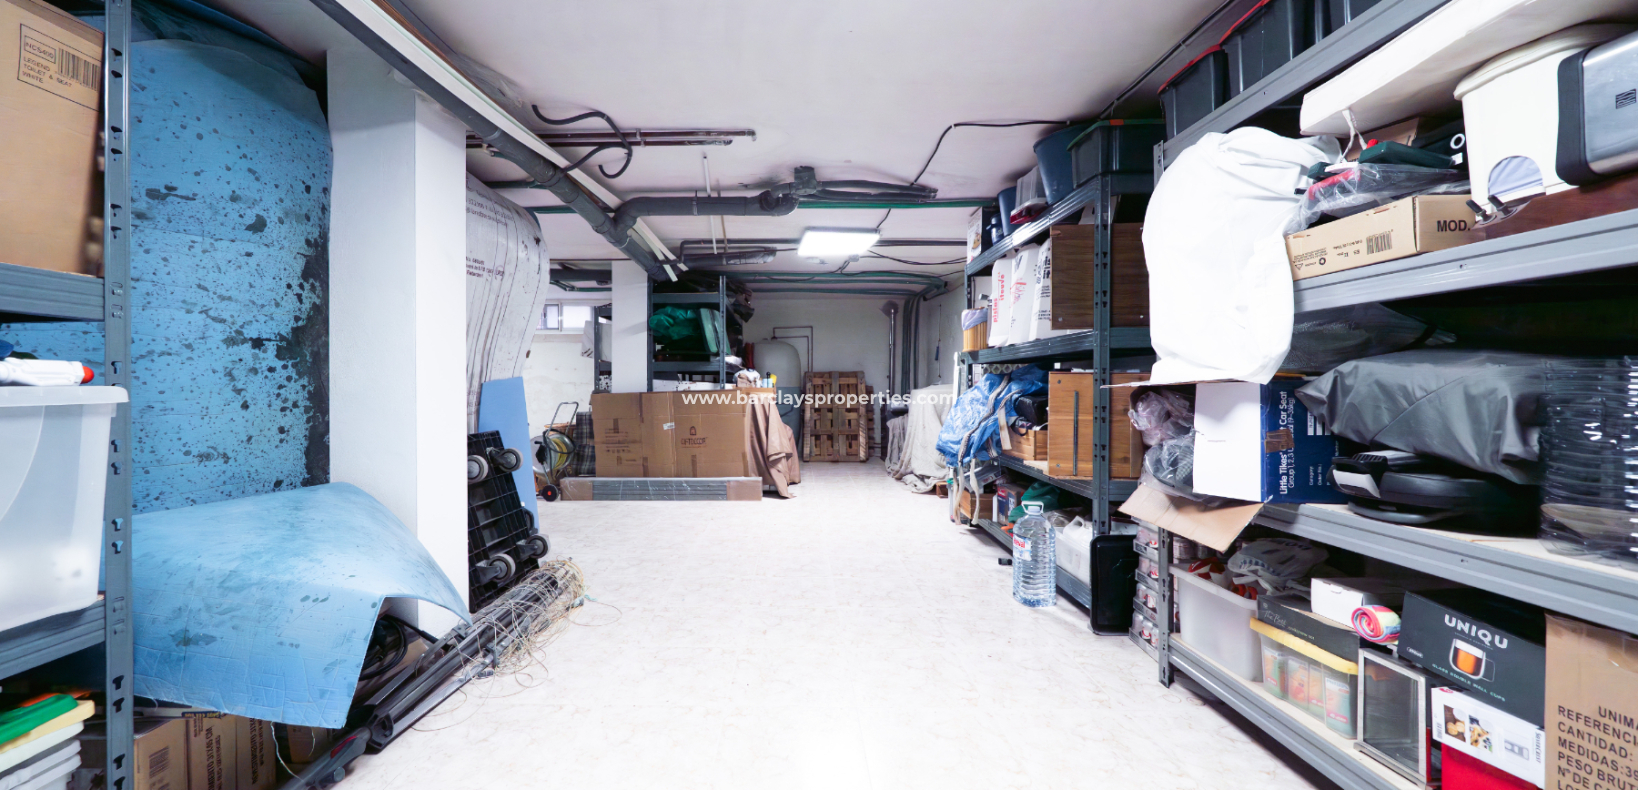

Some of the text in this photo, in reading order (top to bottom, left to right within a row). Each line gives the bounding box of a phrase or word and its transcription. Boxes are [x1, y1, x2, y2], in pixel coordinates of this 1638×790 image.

[23, 56, 51, 72] LEGEND
[22, 70, 44, 84] WHITE
[23, 63, 46, 77] TOILET
[56, 77, 72, 87] SEAT
[1436, 219, 1472, 233] MOD.
[1279, 391, 1288, 410] Seat
[1279, 411, 1287, 425] Car
[1279, 475, 1288, 494] Little
[1444, 613, 1508, 649] UNIQU
[1432, 663, 1506, 702] GLASS DOUBLE WALL CUPS
[1558, 705, 1638, 747] REFERENCI
[1598, 705, 1638, 731] UNIM
[1557, 721, 1633, 762] CANTIDAD:
[1557, 751, 1638, 790] PESO BRUT
[1572, 772, 1590, 790] DE
